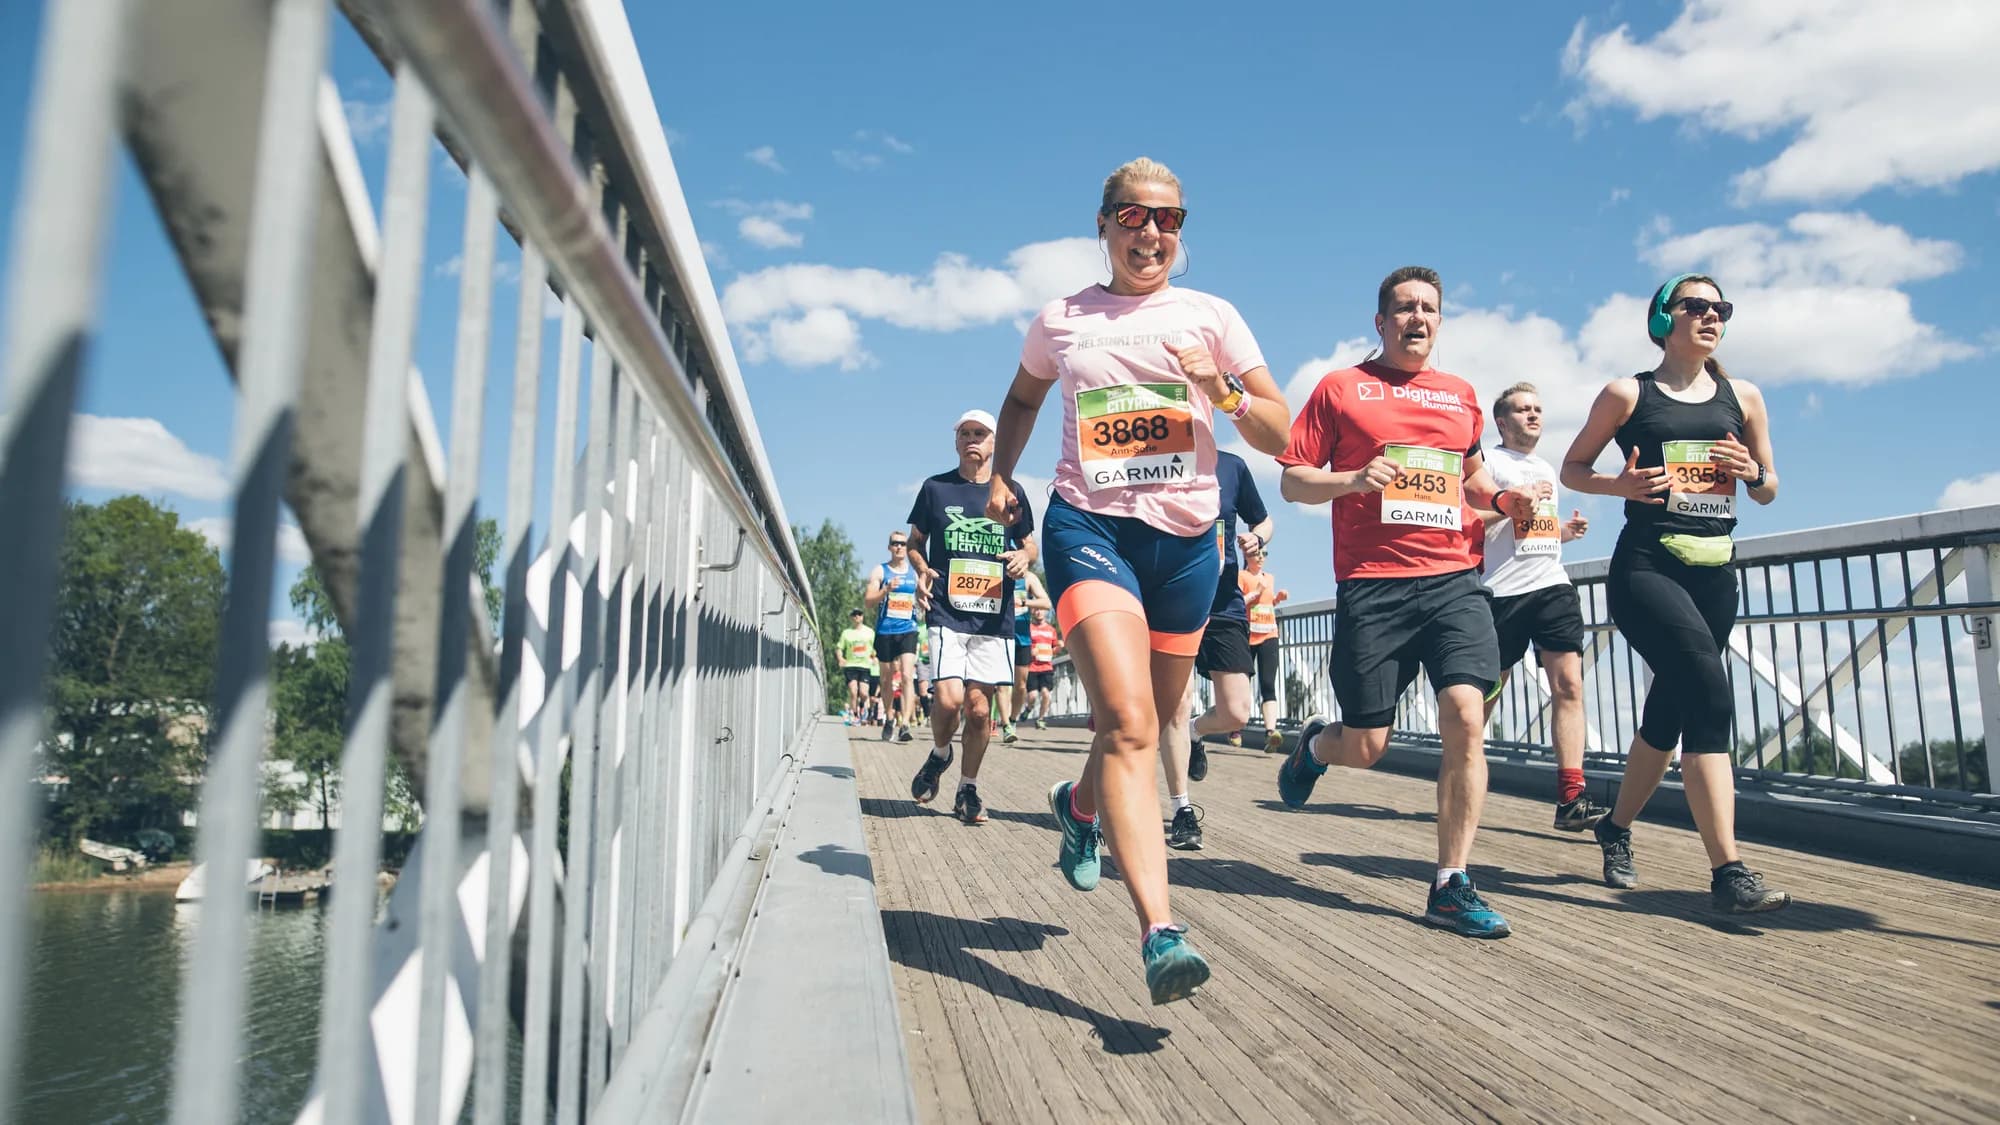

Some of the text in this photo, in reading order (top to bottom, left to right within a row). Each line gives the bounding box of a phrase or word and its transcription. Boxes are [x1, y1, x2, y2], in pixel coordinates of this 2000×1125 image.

[1392, 386, 1461, 406] Digitalist
[1093, 415, 1169, 446] 3868
[1111, 444, 1158, 456] Ann-Sofie
[1094, 465, 1184, 485] GARMIN
[1395, 473, 1447, 494] 3453
[1677, 501, 1731, 514] GARMIN
[1390, 510, 1454, 526] GARMIN
[1520, 519, 1554, 532] 3808
[944, 531, 1005, 551] HELSINKI
[958, 543, 1004, 556] CITY RUN
[1080, 546, 1113, 566] CRAFT
[956, 576, 991, 590] 2877
[954, 601, 996, 611] GARMIN
